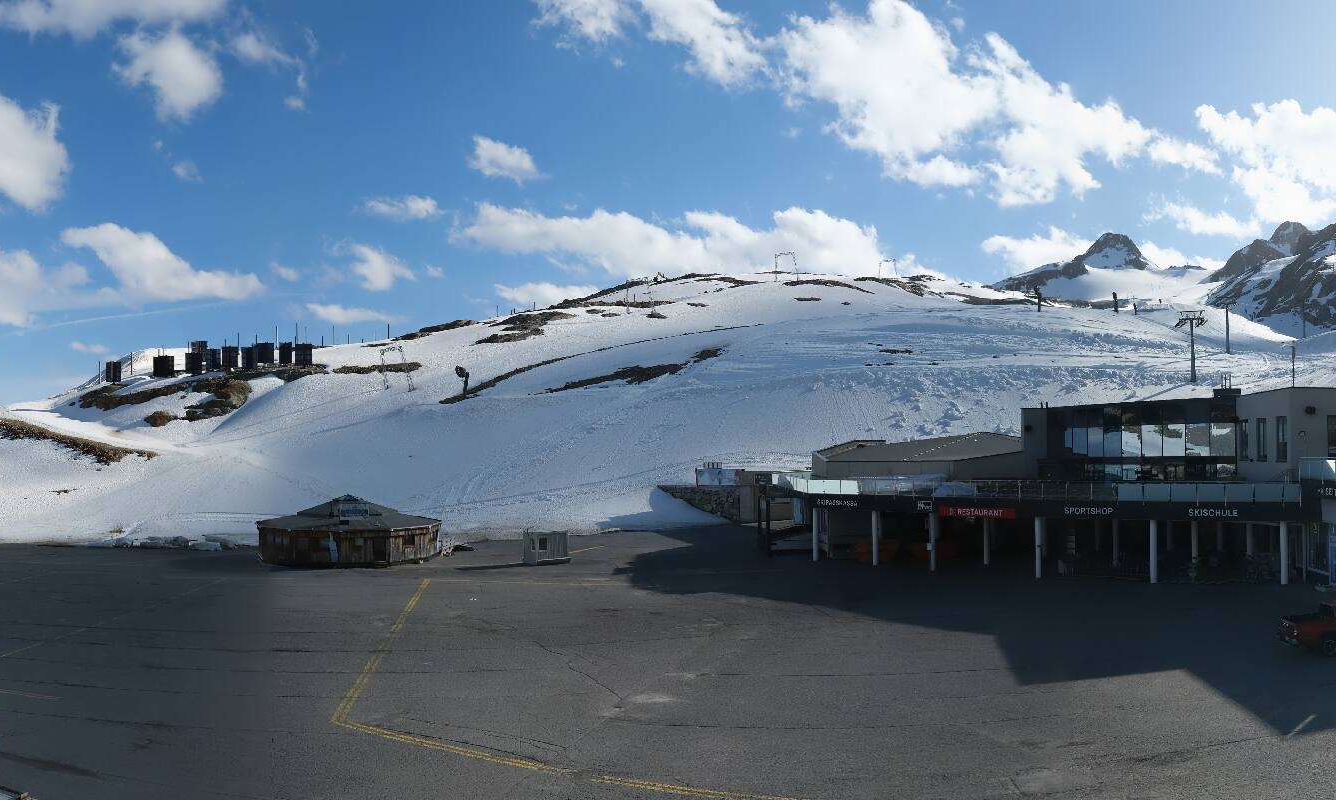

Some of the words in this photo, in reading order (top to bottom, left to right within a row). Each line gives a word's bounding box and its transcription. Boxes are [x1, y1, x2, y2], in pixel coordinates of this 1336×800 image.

[957, 508, 1004, 518] RESTAURANT
[1063, 506, 1115, 516] SPORTSHOP
[1188, 507, 1239, 518] SKISCHULE
